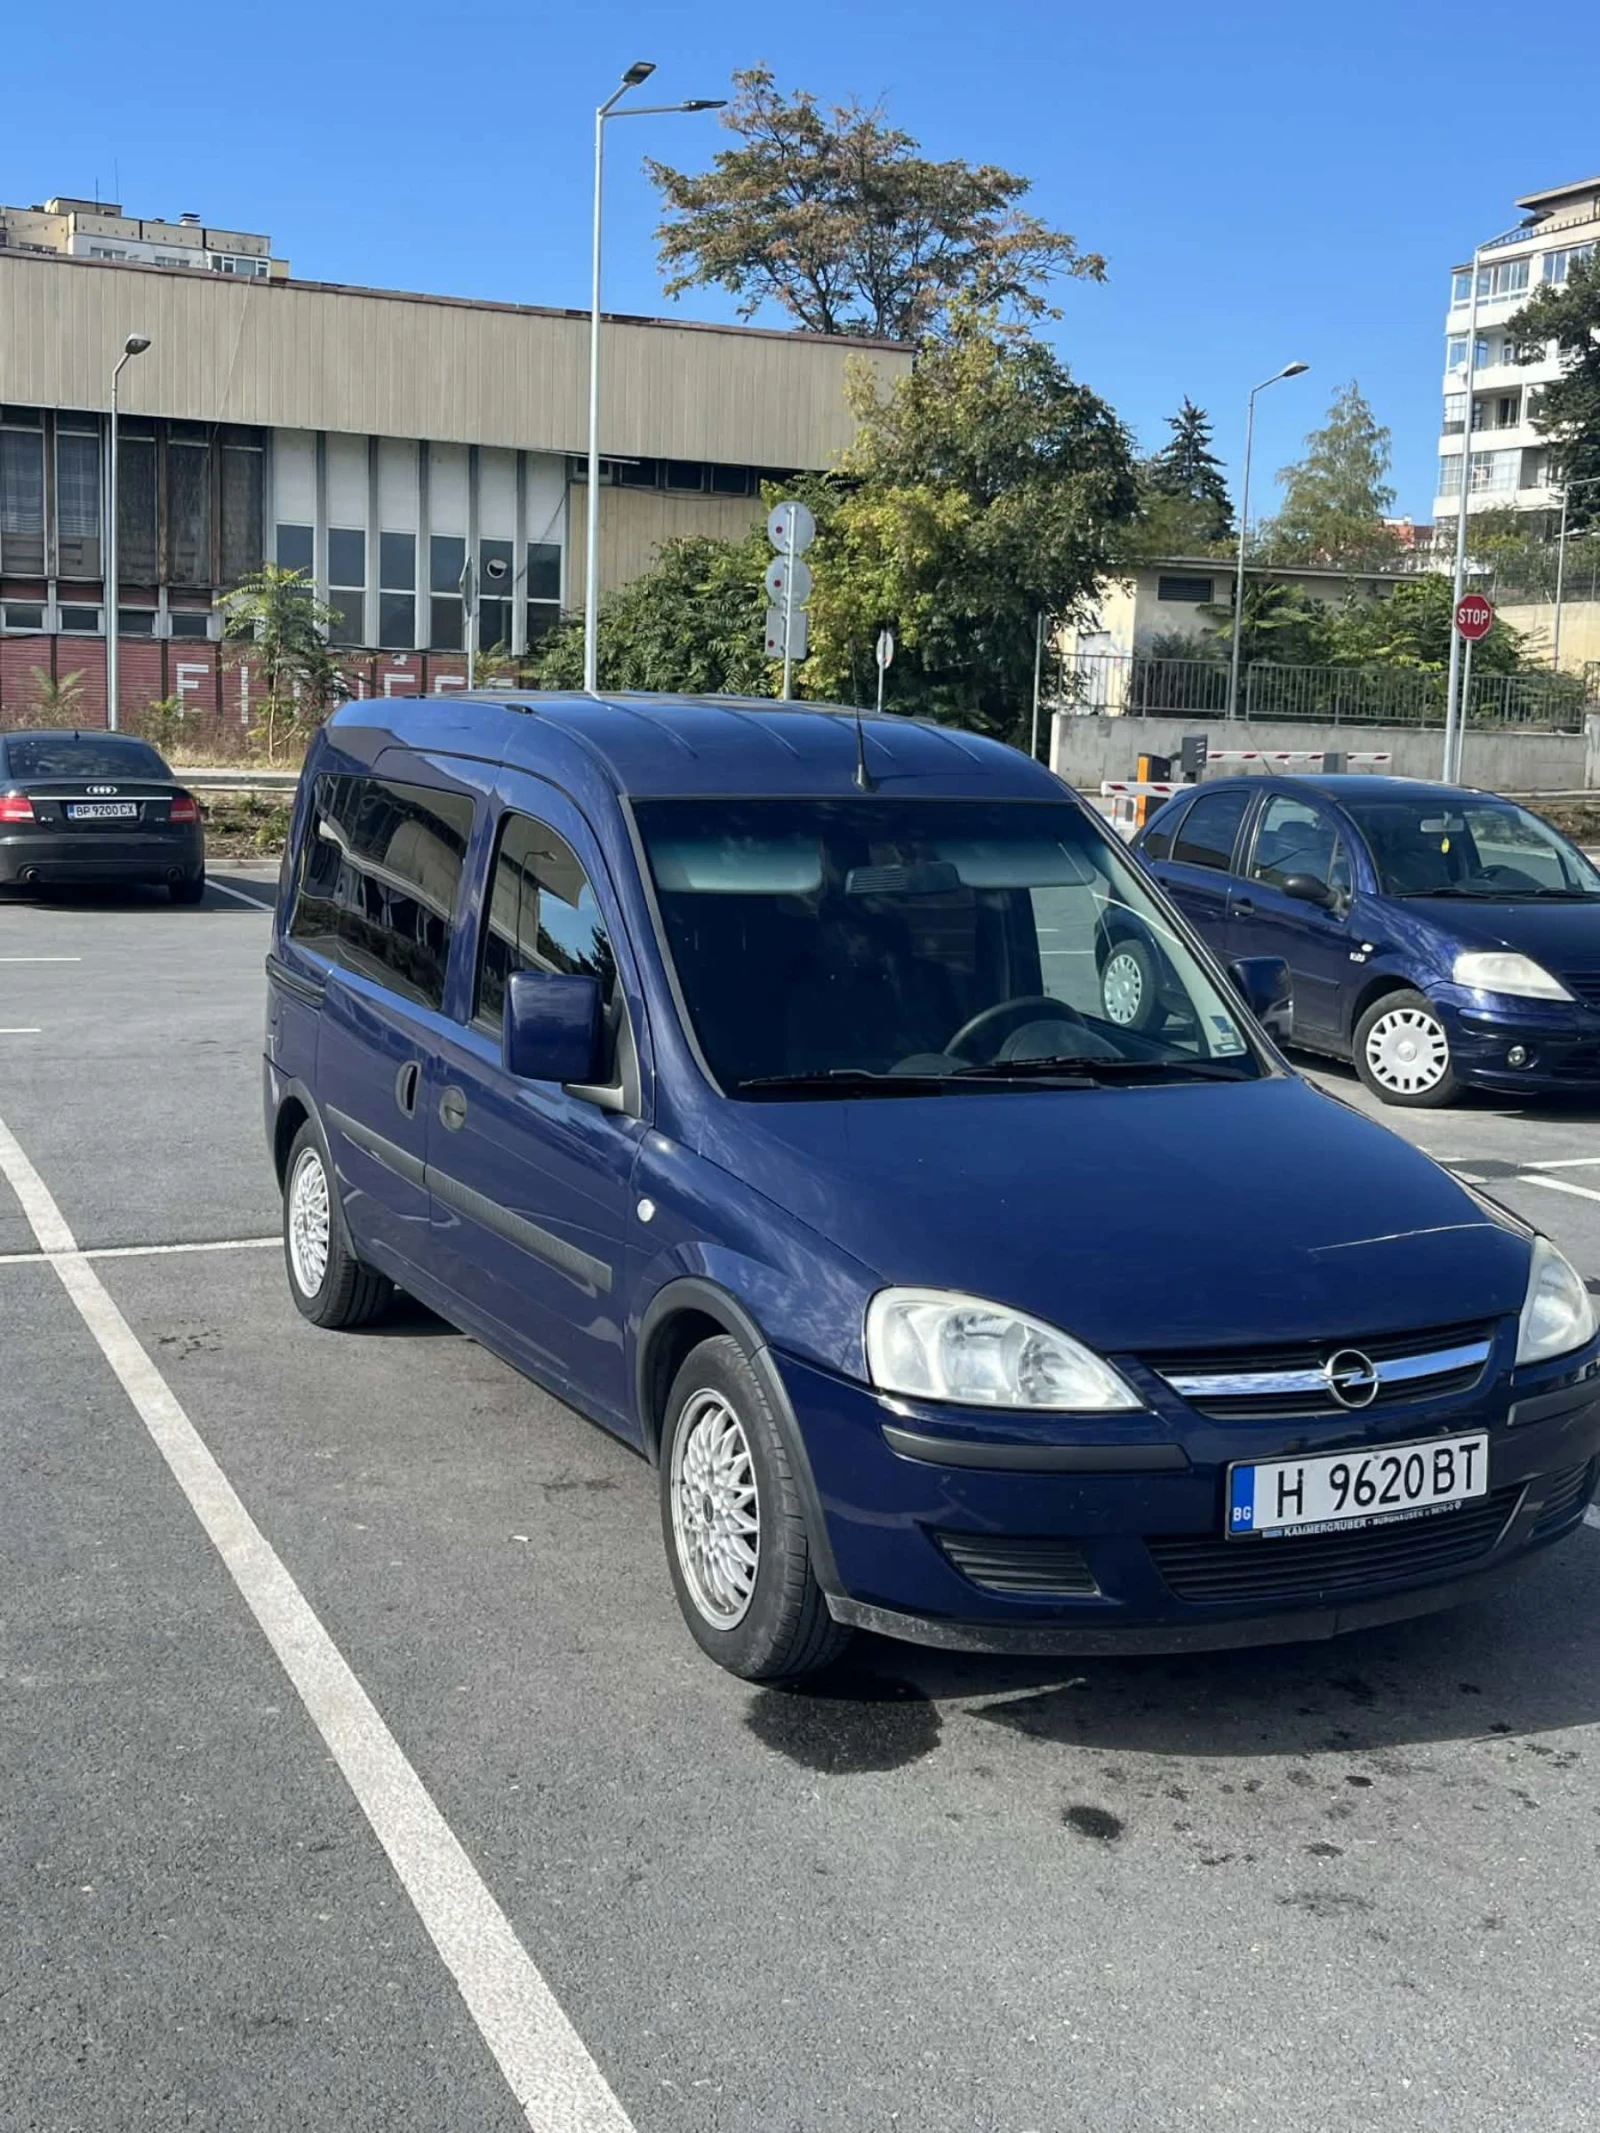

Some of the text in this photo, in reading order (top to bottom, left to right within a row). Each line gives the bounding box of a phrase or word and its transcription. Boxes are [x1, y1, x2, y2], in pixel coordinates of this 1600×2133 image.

[1458, 608, 1489, 625] STOP
[92, 805, 118, 816] 9200
[1277, 1467, 1304, 1518] H
[1233, 1506, 1251, 1521] BG
